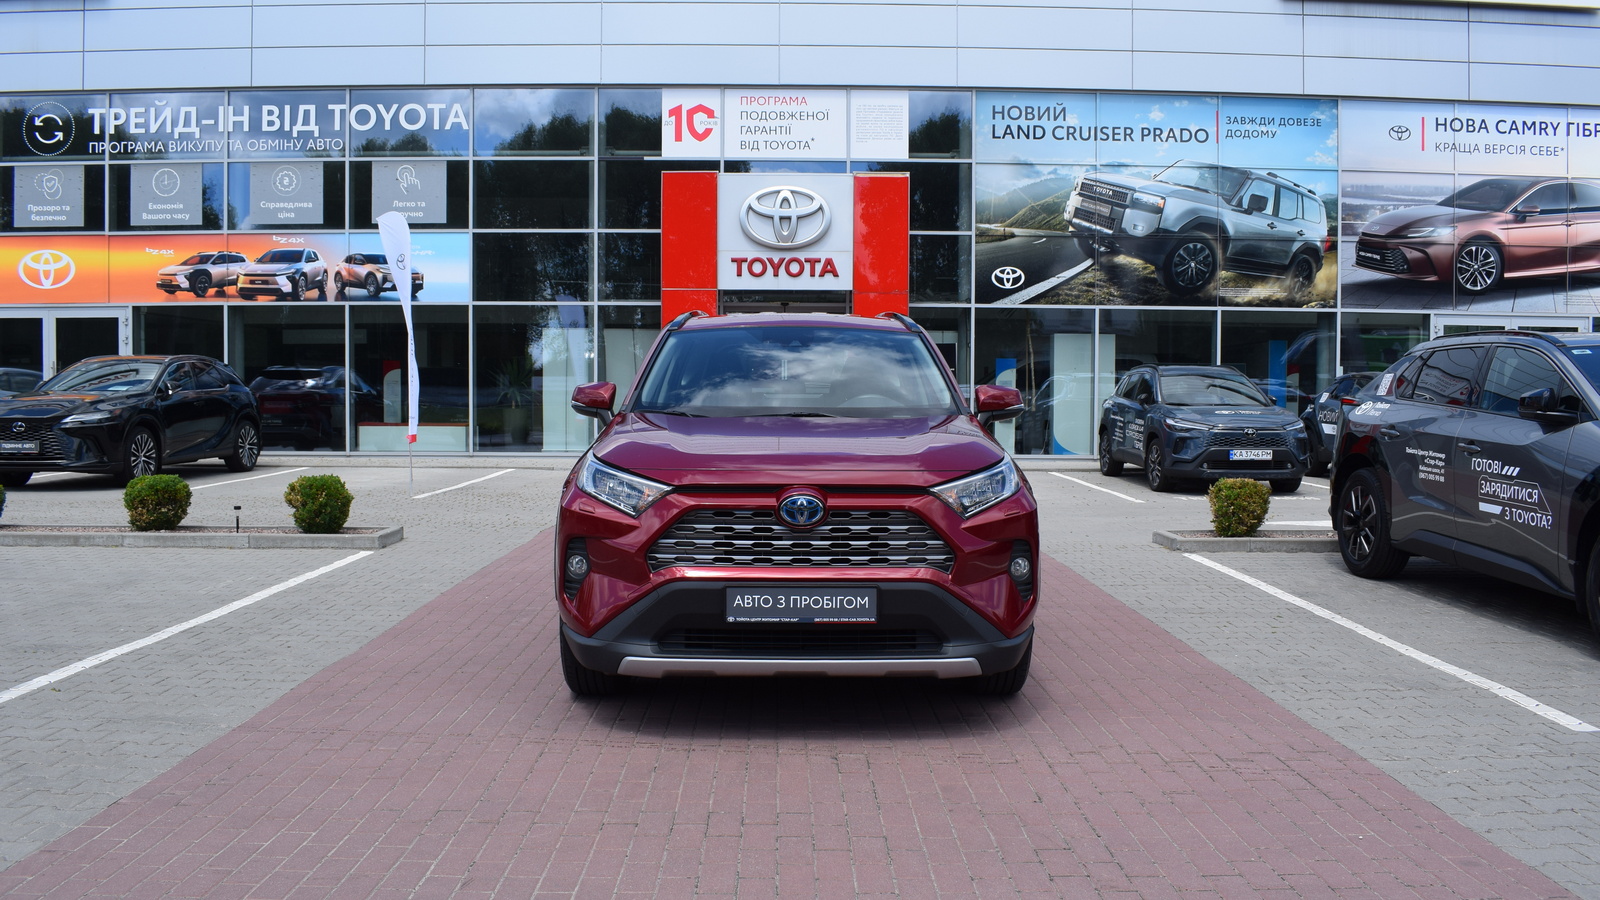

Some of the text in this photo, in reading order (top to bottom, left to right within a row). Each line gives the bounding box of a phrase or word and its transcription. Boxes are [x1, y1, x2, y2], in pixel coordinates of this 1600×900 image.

[740, 96, 808, 106] ПРОГРАМА
[740, 109, 829, 122] ПОДОВЖЕНОЇ
[992, 103, 1067, 121] НОВИЙ
[88, 100, 470, 139] ТРЕЙД-ІН ВІД TOYOTA
[1225, 115, 1322, 128] ЗАВЖДИ ДОВЕЗЕ
[740, 124, 792, 136] ГАРАНТІЇ
[1435, 117, 1489, 134] НОВА
[1495, 119, 1561, 137] CAMRY
[991, 124, 1210, 144] LAND CRUISER PRADO
[1225, 129, 1277, 140] ДОДОМУ
[89, 138, 344, 154] ПРОГРАМА ВИКУПУ ТА ОБМІНУ АВТО
[740, 141, 760, 152] ВІД
[1435, 142, 1481, 154] КРАЩА
[1485, 144, 1526, 155] ВЕРСІЯ
[1093, 186, 1113, 196] TOYOTA
[27, 204, 61, 213] Прозоро
[148, 202, 184, 210] Економія
[260, 201, 313, 210] Справедлива
[392, 200, 416, 208] Легко
[31, 213, 67, 222] безпечно
[142, 212, 190, 221] Вашого часу
[278, 211, 295, 219] ціна
[400, 211, 424, 219] учно
[730, 257, 840, 278] TOYOTA
[1471, 457, 1502, 474] ГОТОВІ
[1480, 480, 1539, 504] ЗАРЯДИТИСЯ
[1511, 508, 1552, 530] TOYOTA?
[733, 595, 869, 609] АВТО З ПРОБІГОМ
